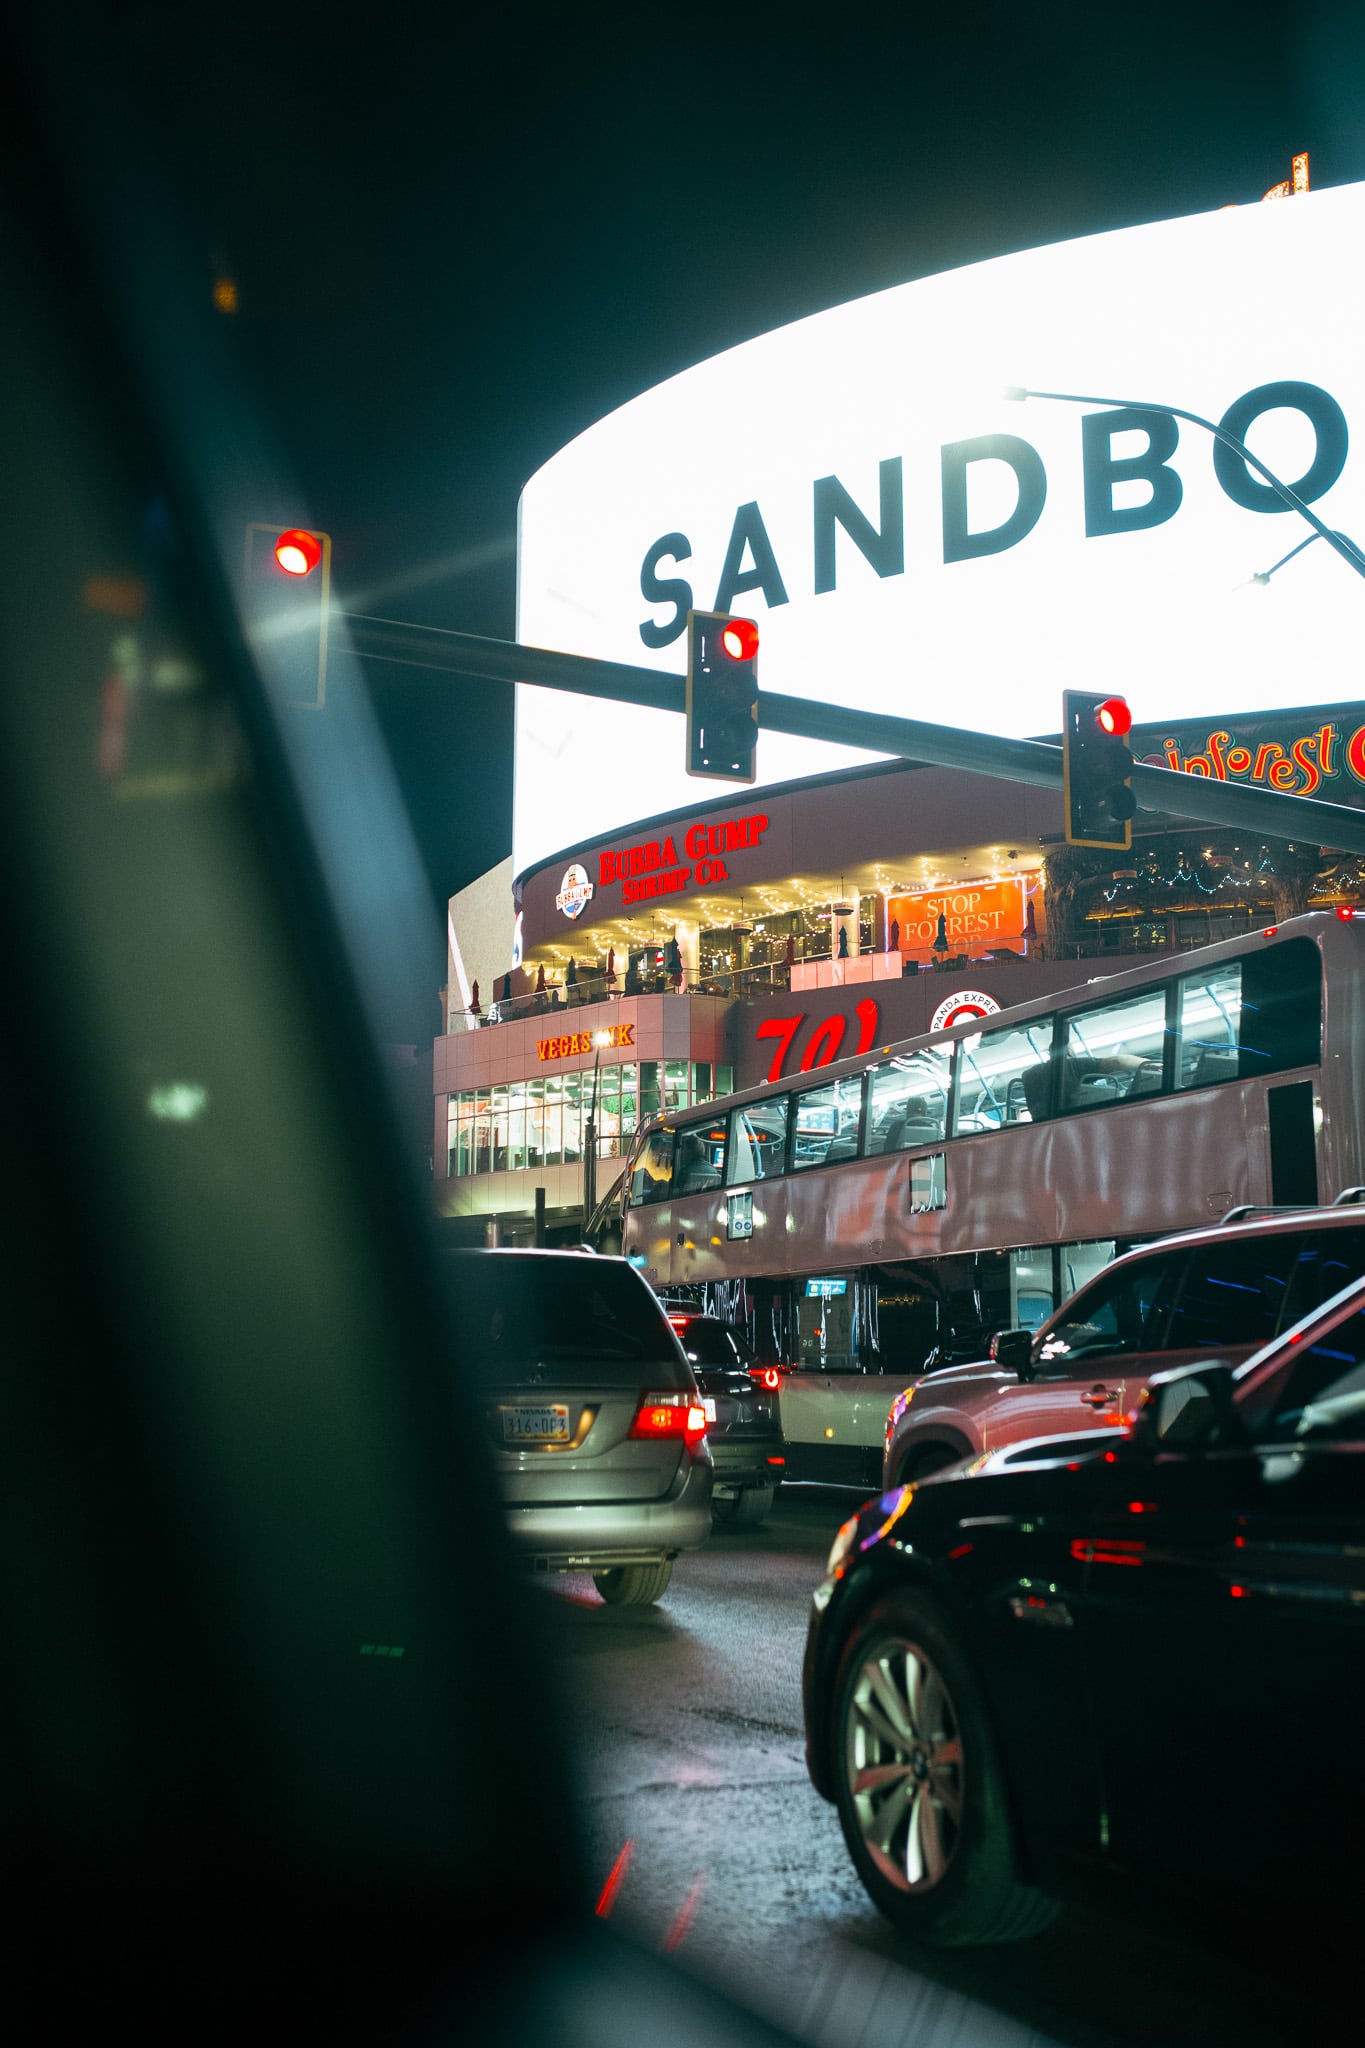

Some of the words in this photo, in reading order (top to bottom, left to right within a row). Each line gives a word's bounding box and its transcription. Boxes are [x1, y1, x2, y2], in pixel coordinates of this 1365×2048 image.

[599, 836, 678, 886] BUBBA
[684, 814, 768, 860] GUMP
[622, 868, 690, 905] SHRIMP
[694, 860, 729, 886] CO.
[927, 893, 981, 918] STOP
[934, 997, 960, 1029] PANDA
[536, 1031, 591, 1061] VEGAS
